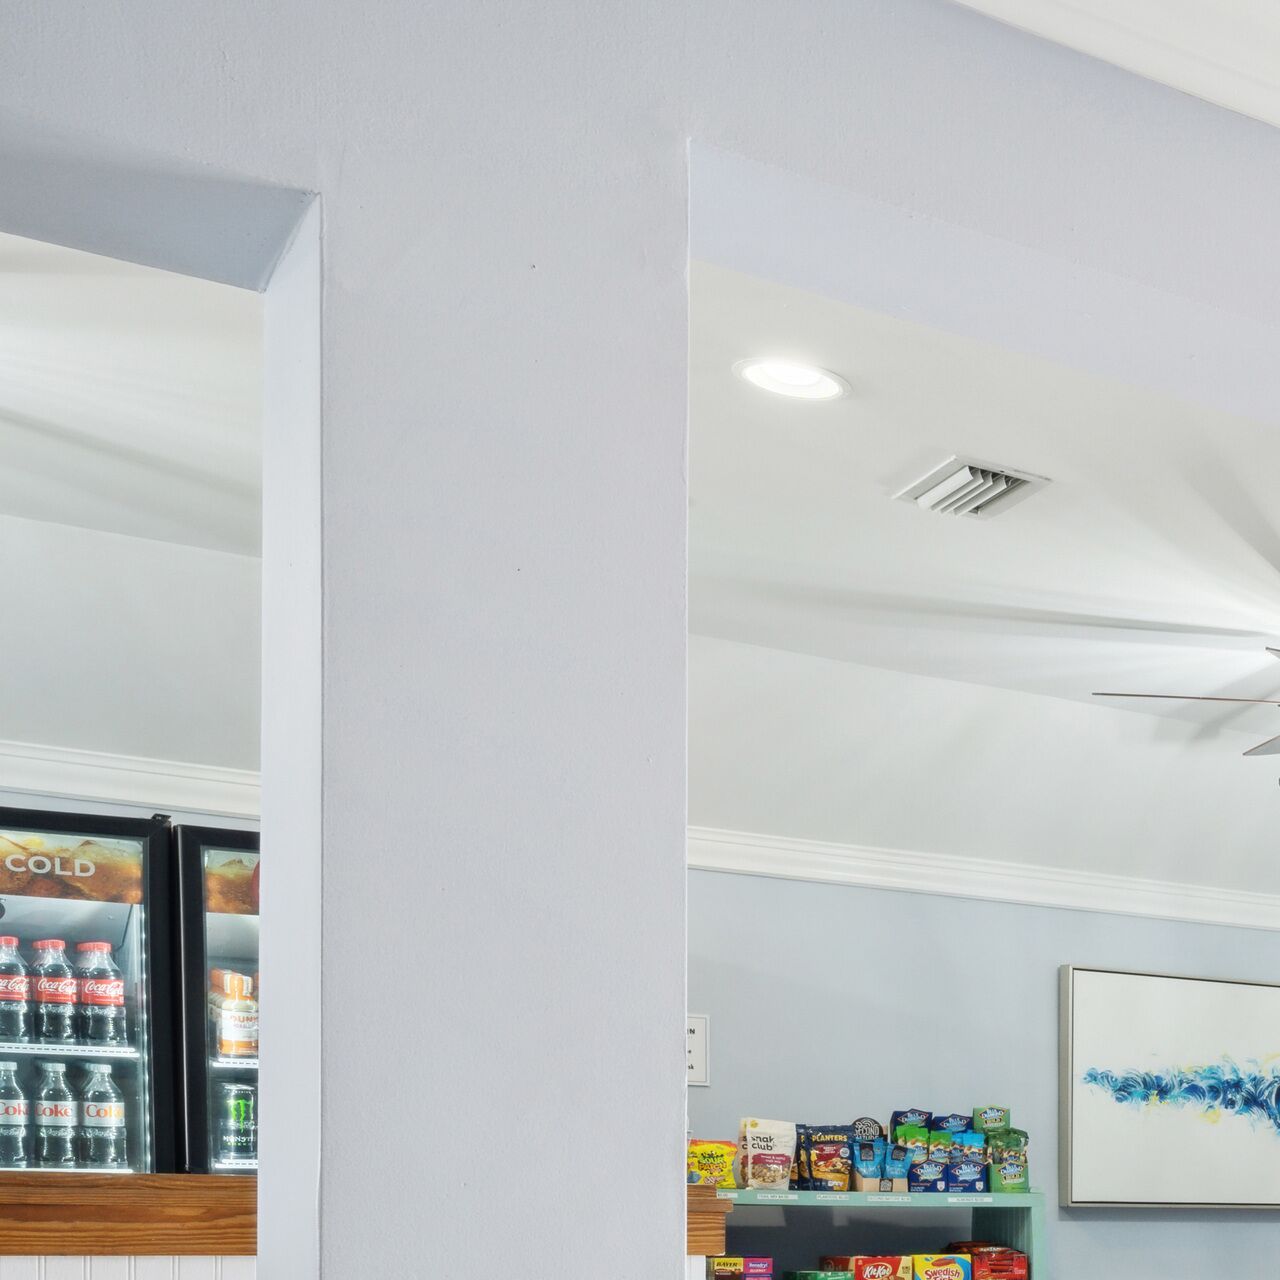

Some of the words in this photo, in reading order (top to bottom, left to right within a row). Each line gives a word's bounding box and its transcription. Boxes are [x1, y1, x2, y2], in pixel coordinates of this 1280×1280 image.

[5, 854, 96, 877] COLD
[35, 1103, 71, 1117] Coke
[751, 1135, 774, 1143] snak
[811, 1134, 848, 1142] PLANTERS
[751, 1143, 773, 1151] club
[863, 1265, 890, 1279] KitKat
[924, 1267, 961, 1280] Swedish
